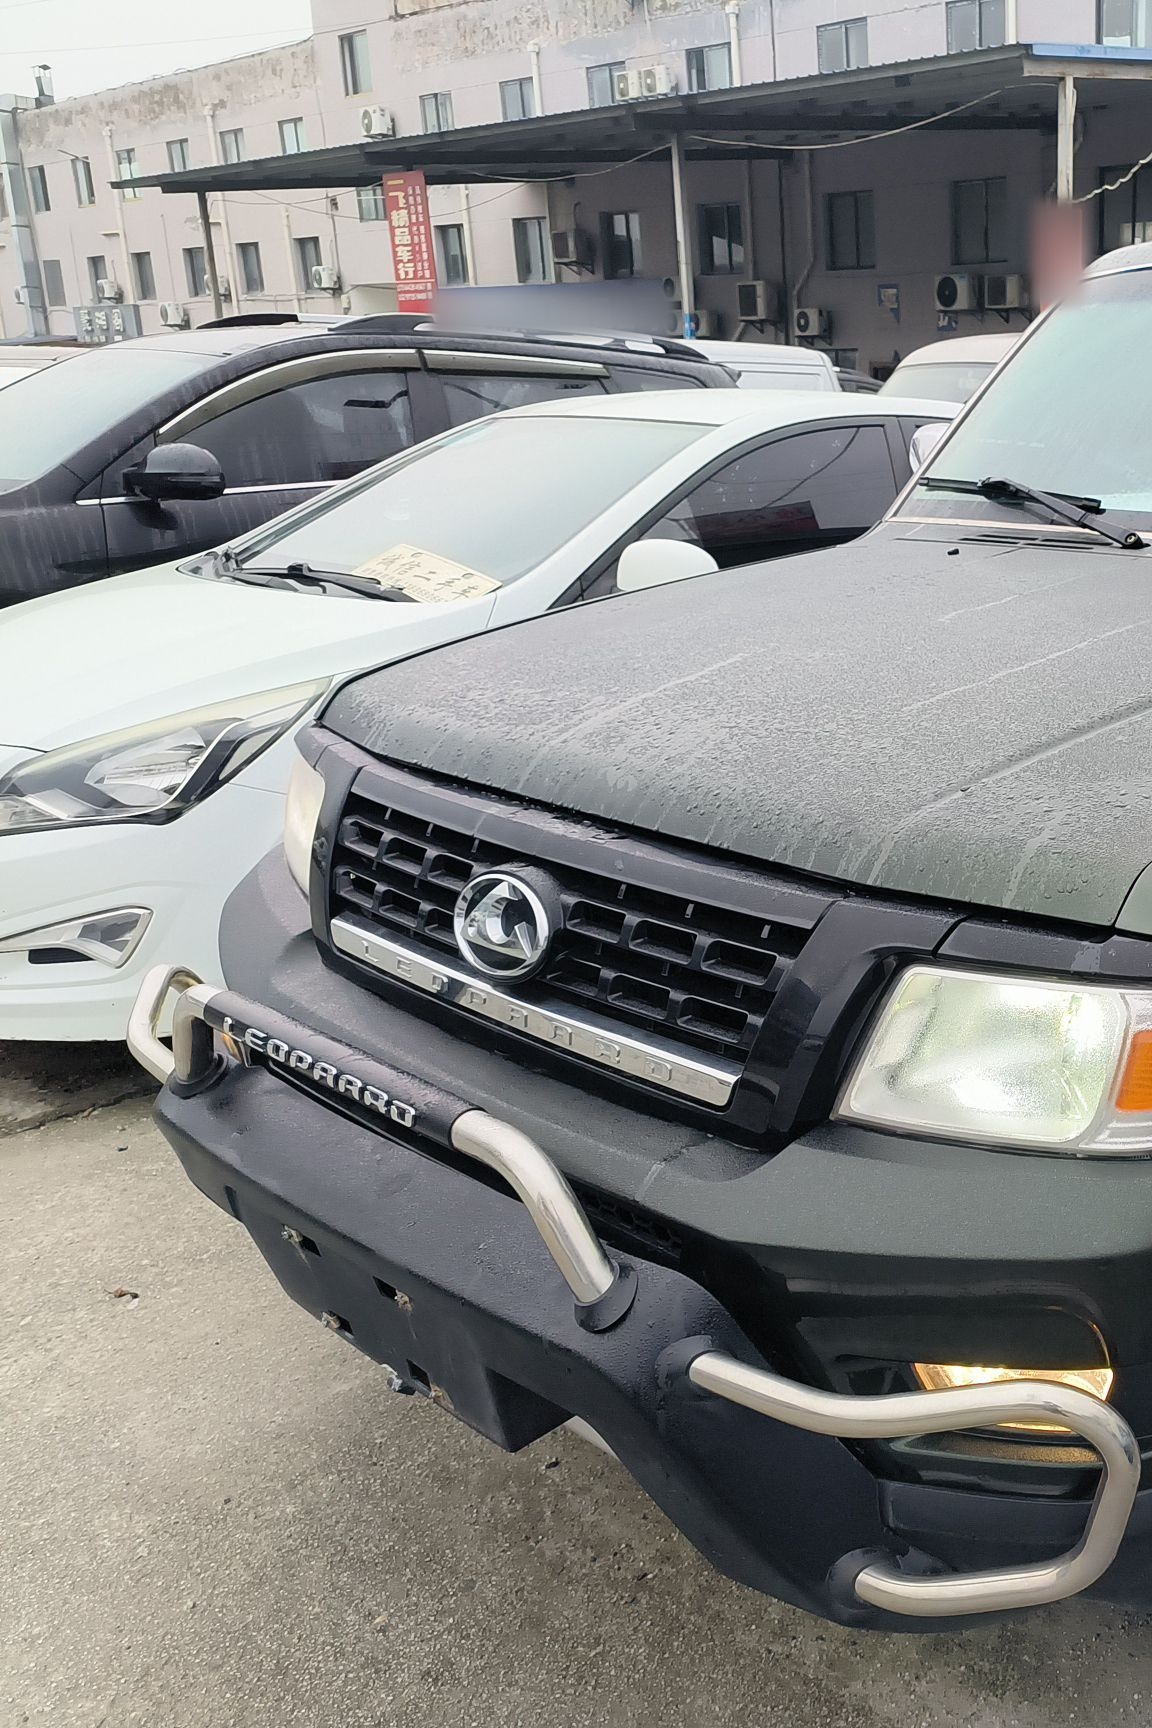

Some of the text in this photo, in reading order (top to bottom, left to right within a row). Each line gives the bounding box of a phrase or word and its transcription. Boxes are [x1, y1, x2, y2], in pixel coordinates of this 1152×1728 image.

[387, 178, 415, 280] 一飞精品车行
[361, 940, 673, 1082] LEOPAARD
